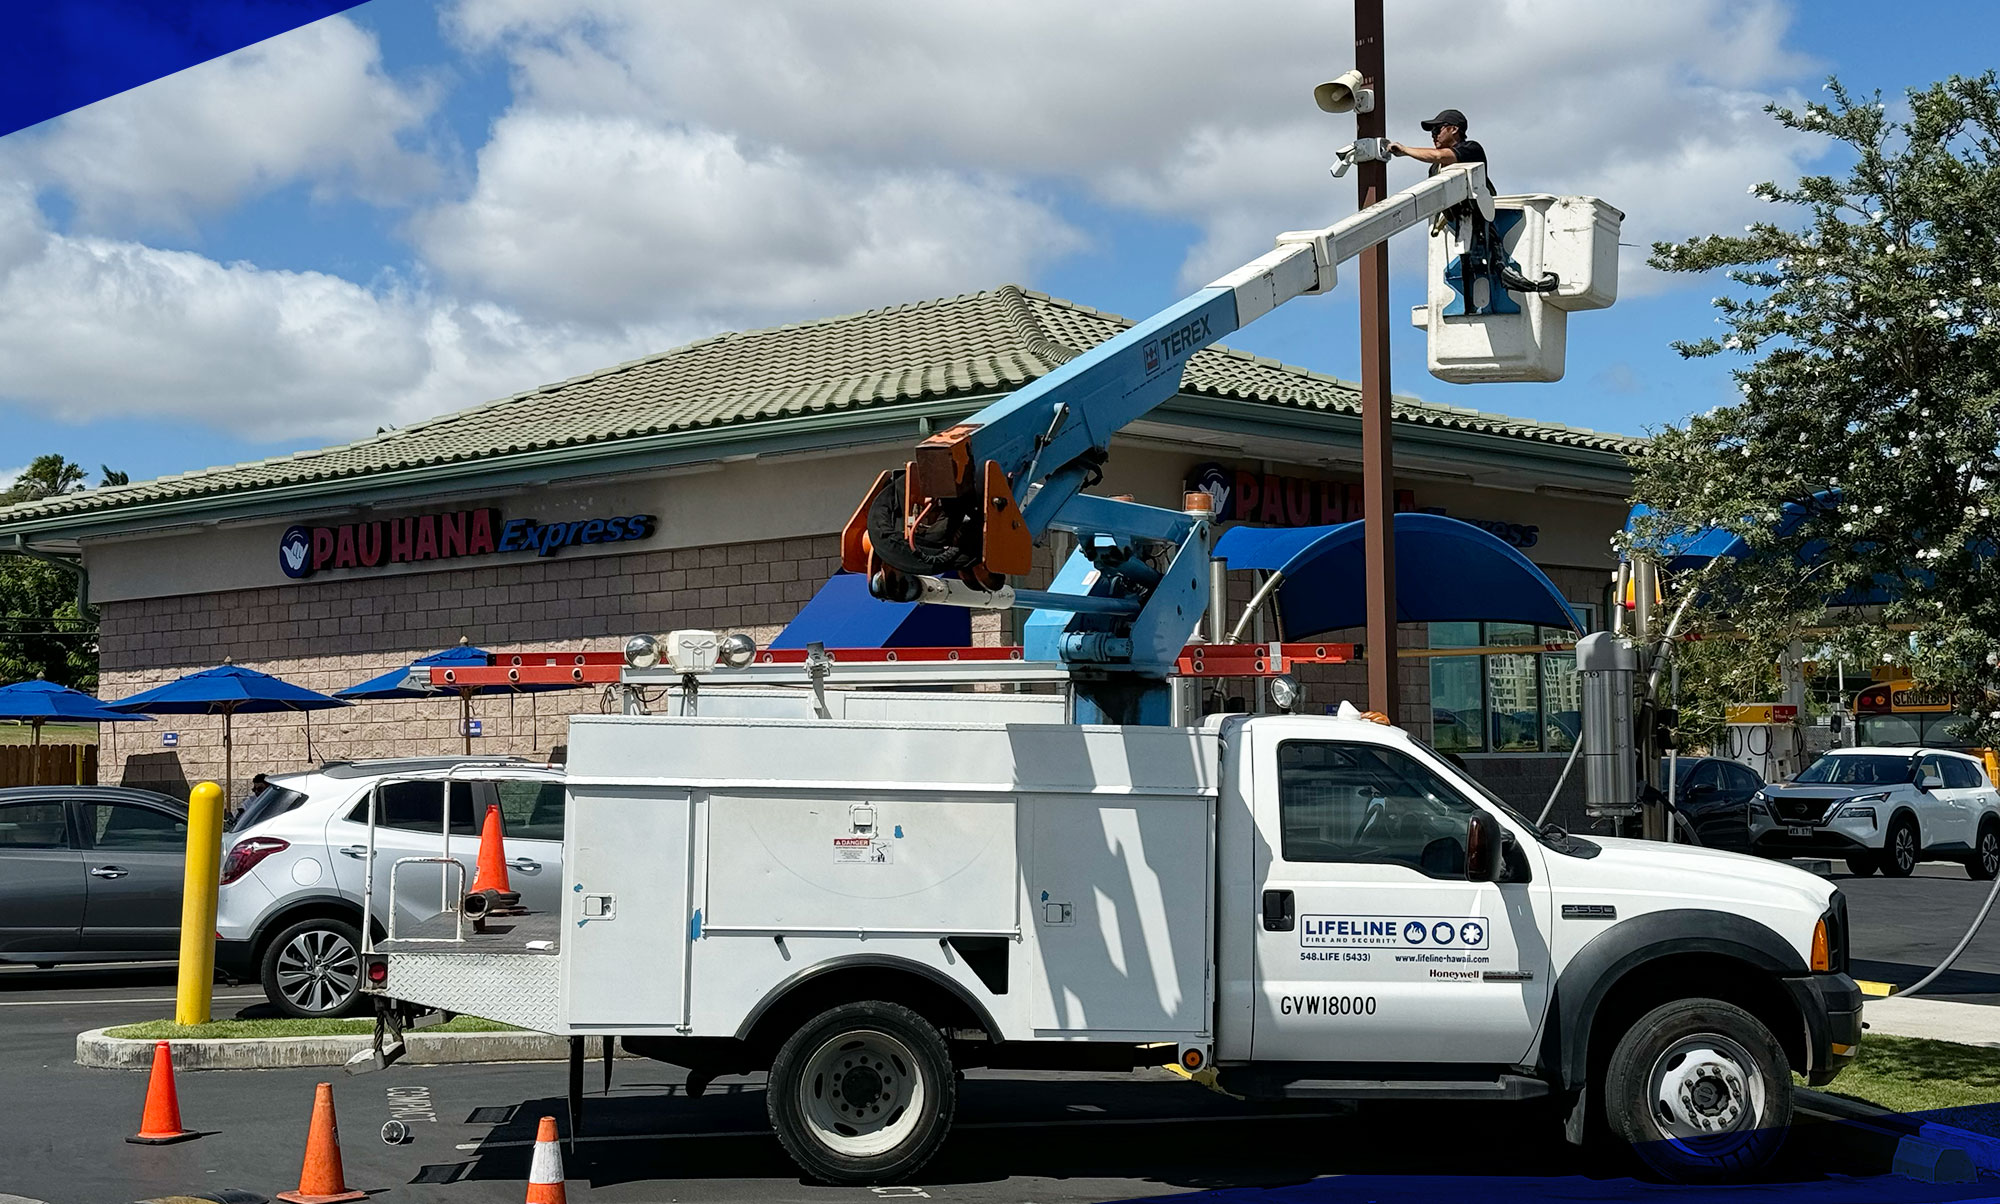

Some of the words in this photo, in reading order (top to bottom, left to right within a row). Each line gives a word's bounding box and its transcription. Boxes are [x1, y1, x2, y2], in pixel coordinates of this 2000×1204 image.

[1161, 313, 1212, 361] TEREX
[1234, 471, 1311, 526] PAU
[312, 521, 382, 570] PAU
[390, 508, 495, 563] HANA
[497, 515, 649, 557] Express
[1874, 669, 1881, 677] 7
[1902, 668, 1909, 676] 8
[1305, 920, 1397, 936] LIFELINE
[1300, 952, 1340, 961] 548.LIFE
[1343, 952, 1371, 962] (5433)
[1394, 953, 1490, 963] www.lifeline-hawaii.com
[1429, 969, 1480, 980] Honeywell
[1280, 995, 1377, 1015] GVW18000
